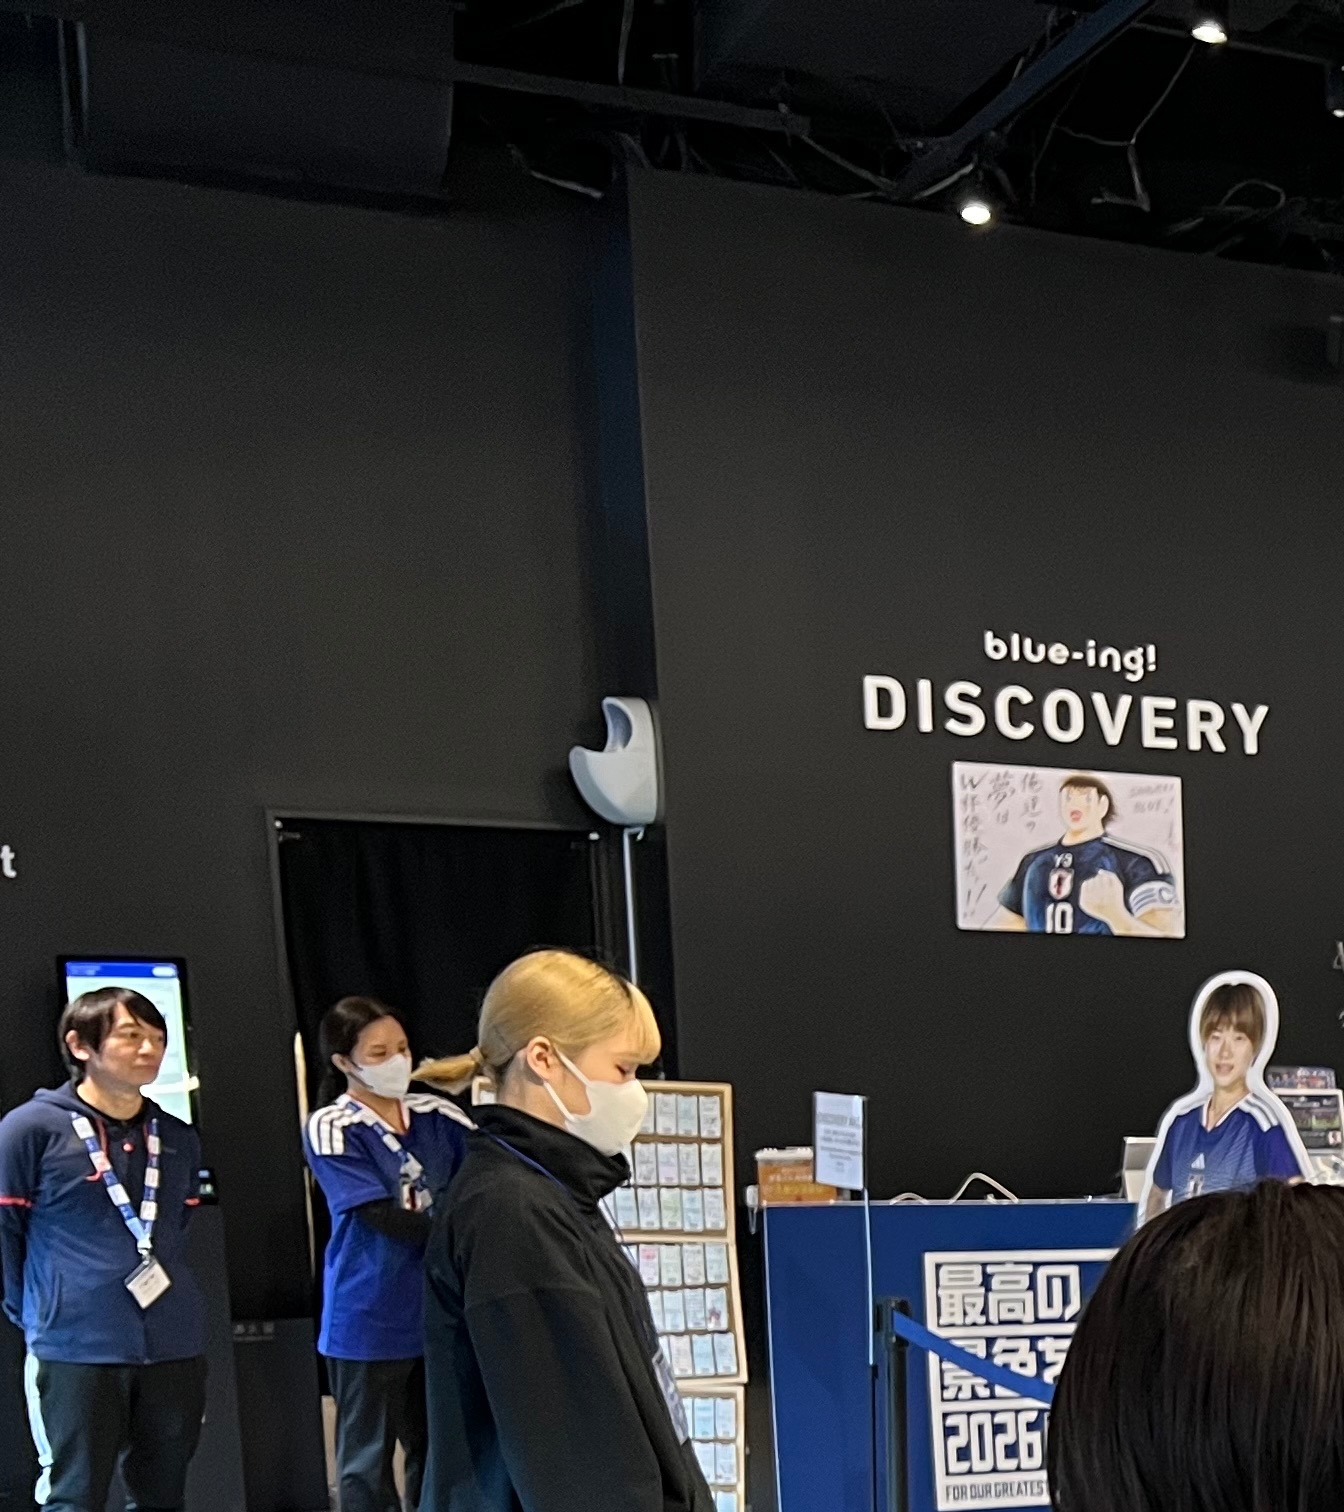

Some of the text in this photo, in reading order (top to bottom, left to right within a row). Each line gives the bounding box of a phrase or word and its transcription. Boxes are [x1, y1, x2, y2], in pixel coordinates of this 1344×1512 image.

[984, 630, 1157, 682] blue-ing!
[863, 675, 1269, 755] DISCOVERY
[1046, 902, 1074, 934] 10
[938, 1262, 1079, 1325] 最高の
[945, 1411, 1042, 1474] 2026
[946, 1484, 968, 1502] FOR
[970, 1482, 992, 1501] OUR
